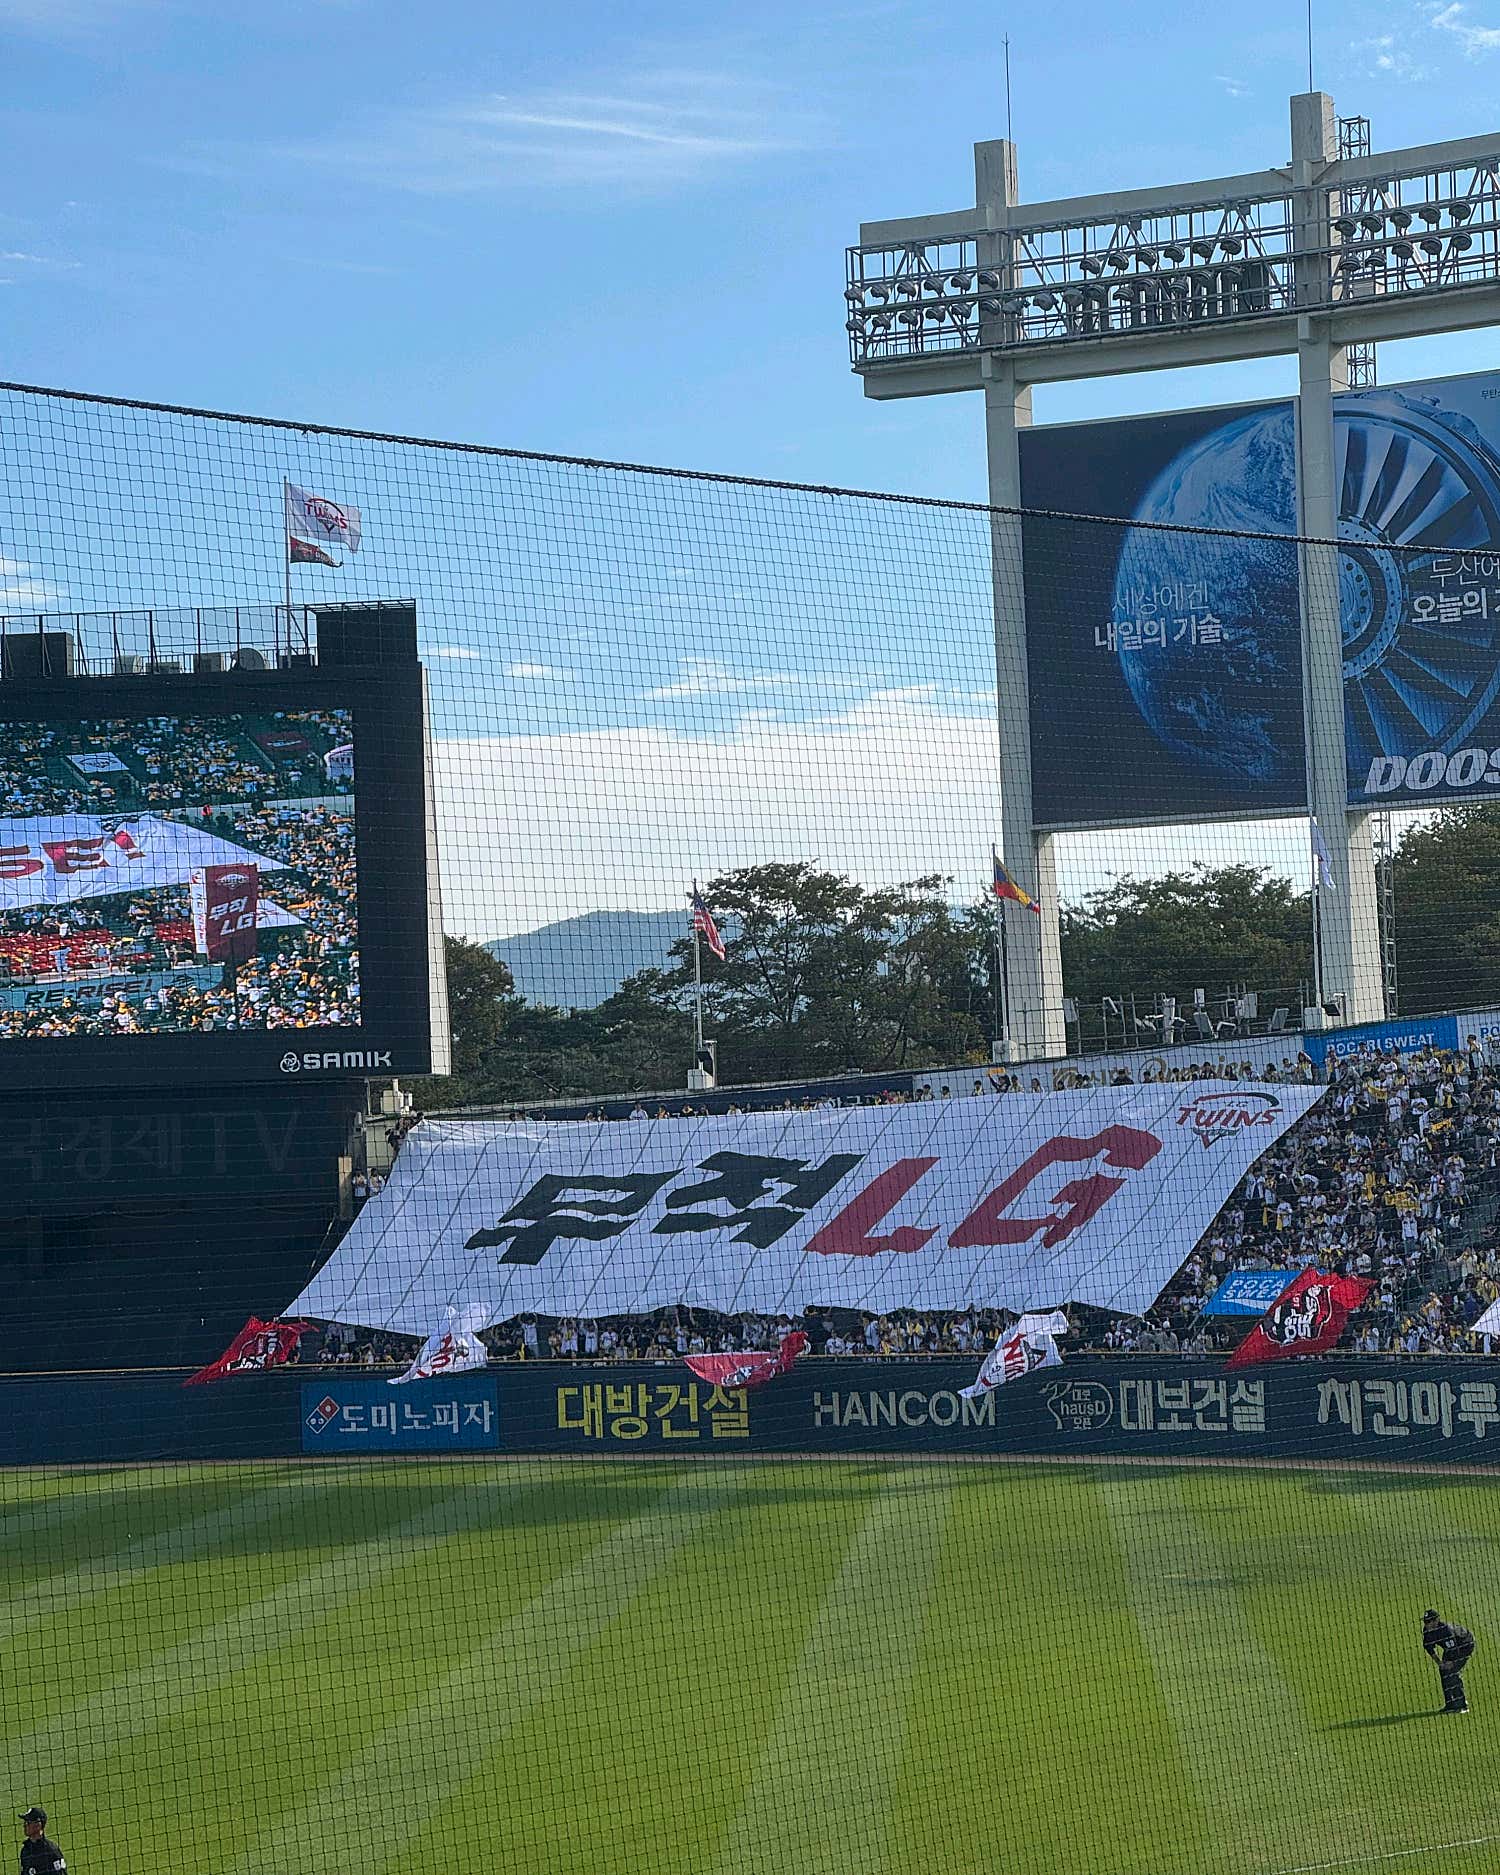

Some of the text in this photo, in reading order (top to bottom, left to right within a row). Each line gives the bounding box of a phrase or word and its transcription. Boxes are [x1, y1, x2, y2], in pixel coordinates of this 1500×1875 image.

[1112, 580, 1209, 615] 세상에겐
[1411, 587, 1488, 623] 오늘의
[1094, 613, 1230, 652] 내일의 기술.
[1384, 1033, 1436, 1050] SWEAT
[303, 1051, 392, 1070] SAMIK
[1176, 1107, 1283, 1127] TWINS
[339, 1401, 494, 1435] 도미노피자
[557, 1383, 750, 1440] 대방건설
[814, 1390, 996, 1427] HANCOM
[1120, 1380, 1265, 1432] 대보건설
[1317, 1377, 1500, 1438] 치킨마루
